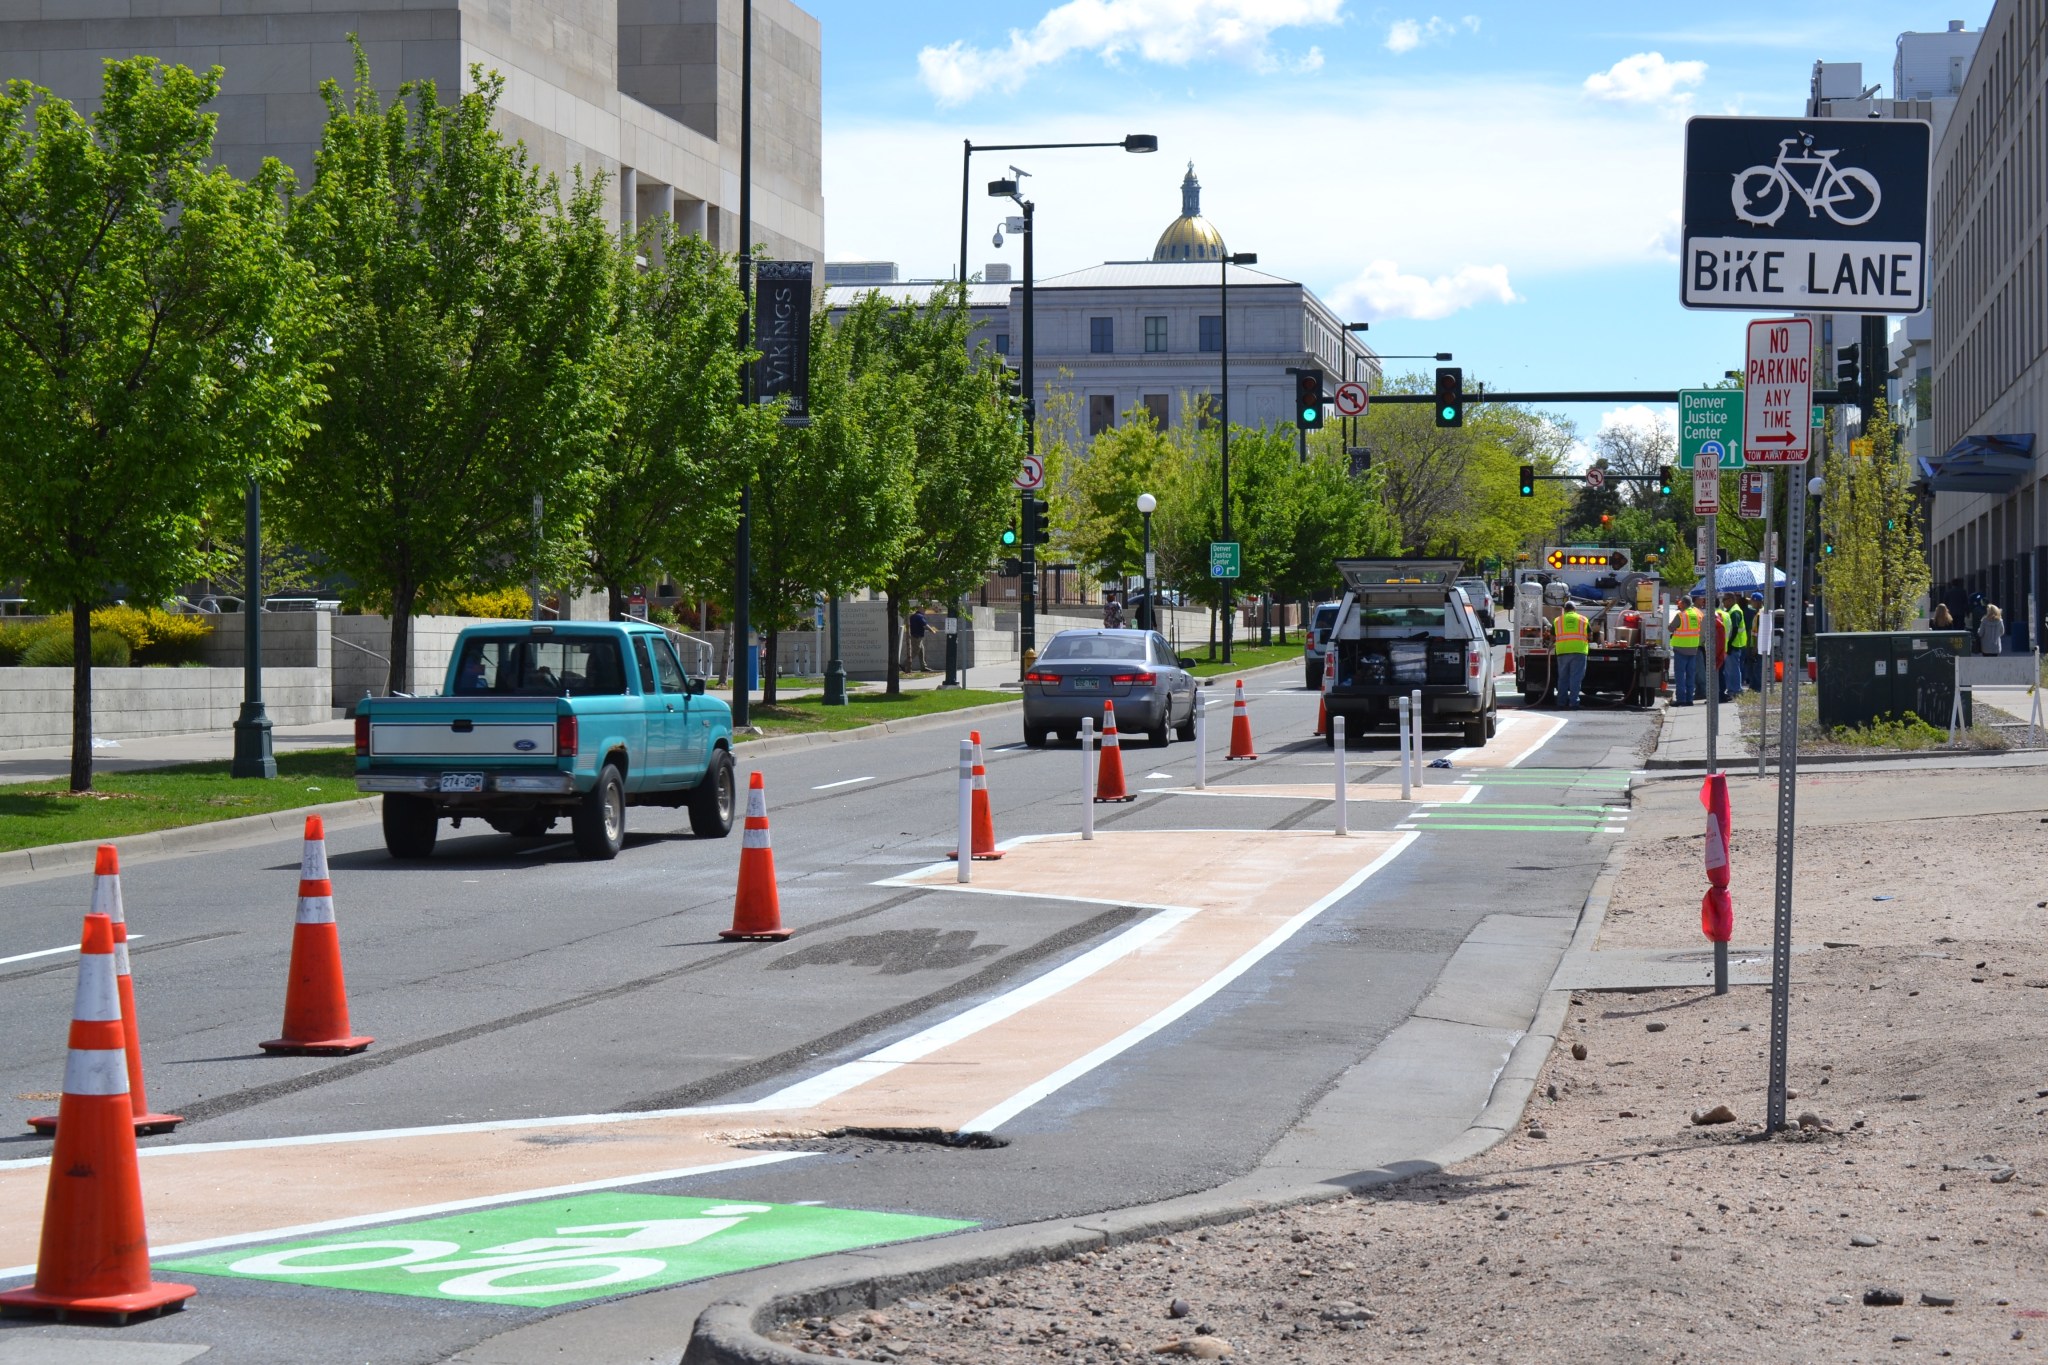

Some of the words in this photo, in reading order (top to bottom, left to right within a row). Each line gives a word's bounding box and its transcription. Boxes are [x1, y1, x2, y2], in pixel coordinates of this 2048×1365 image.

[1694, 249, 1785, 293] BIKE
[1807, 252, 1912, 296] LANE
[763, 287, 792, 388] VIKINGS
[1770, 327, 1789, 353] NO
[1750, 357, 1807, 385] PARKING
[1684, 394, 1726, 409] Denver
[1764, 389, 1791, 407] ANY
[1684, 410, 1728, 424] Justice
[1763, 410, 1792, 428] TIME
[1684, 426, 1722, 439] Center
[1701, 457, 1711, 468] NO
[1748, 451, 1761, 461] TOW
[1764, 450, 1783, 460] AWAY
[1786, 450, 1805, 460] ZONE
[1695, 469, 1717, 480] PARKING
[1701, 481, 1711, 489] ANY
